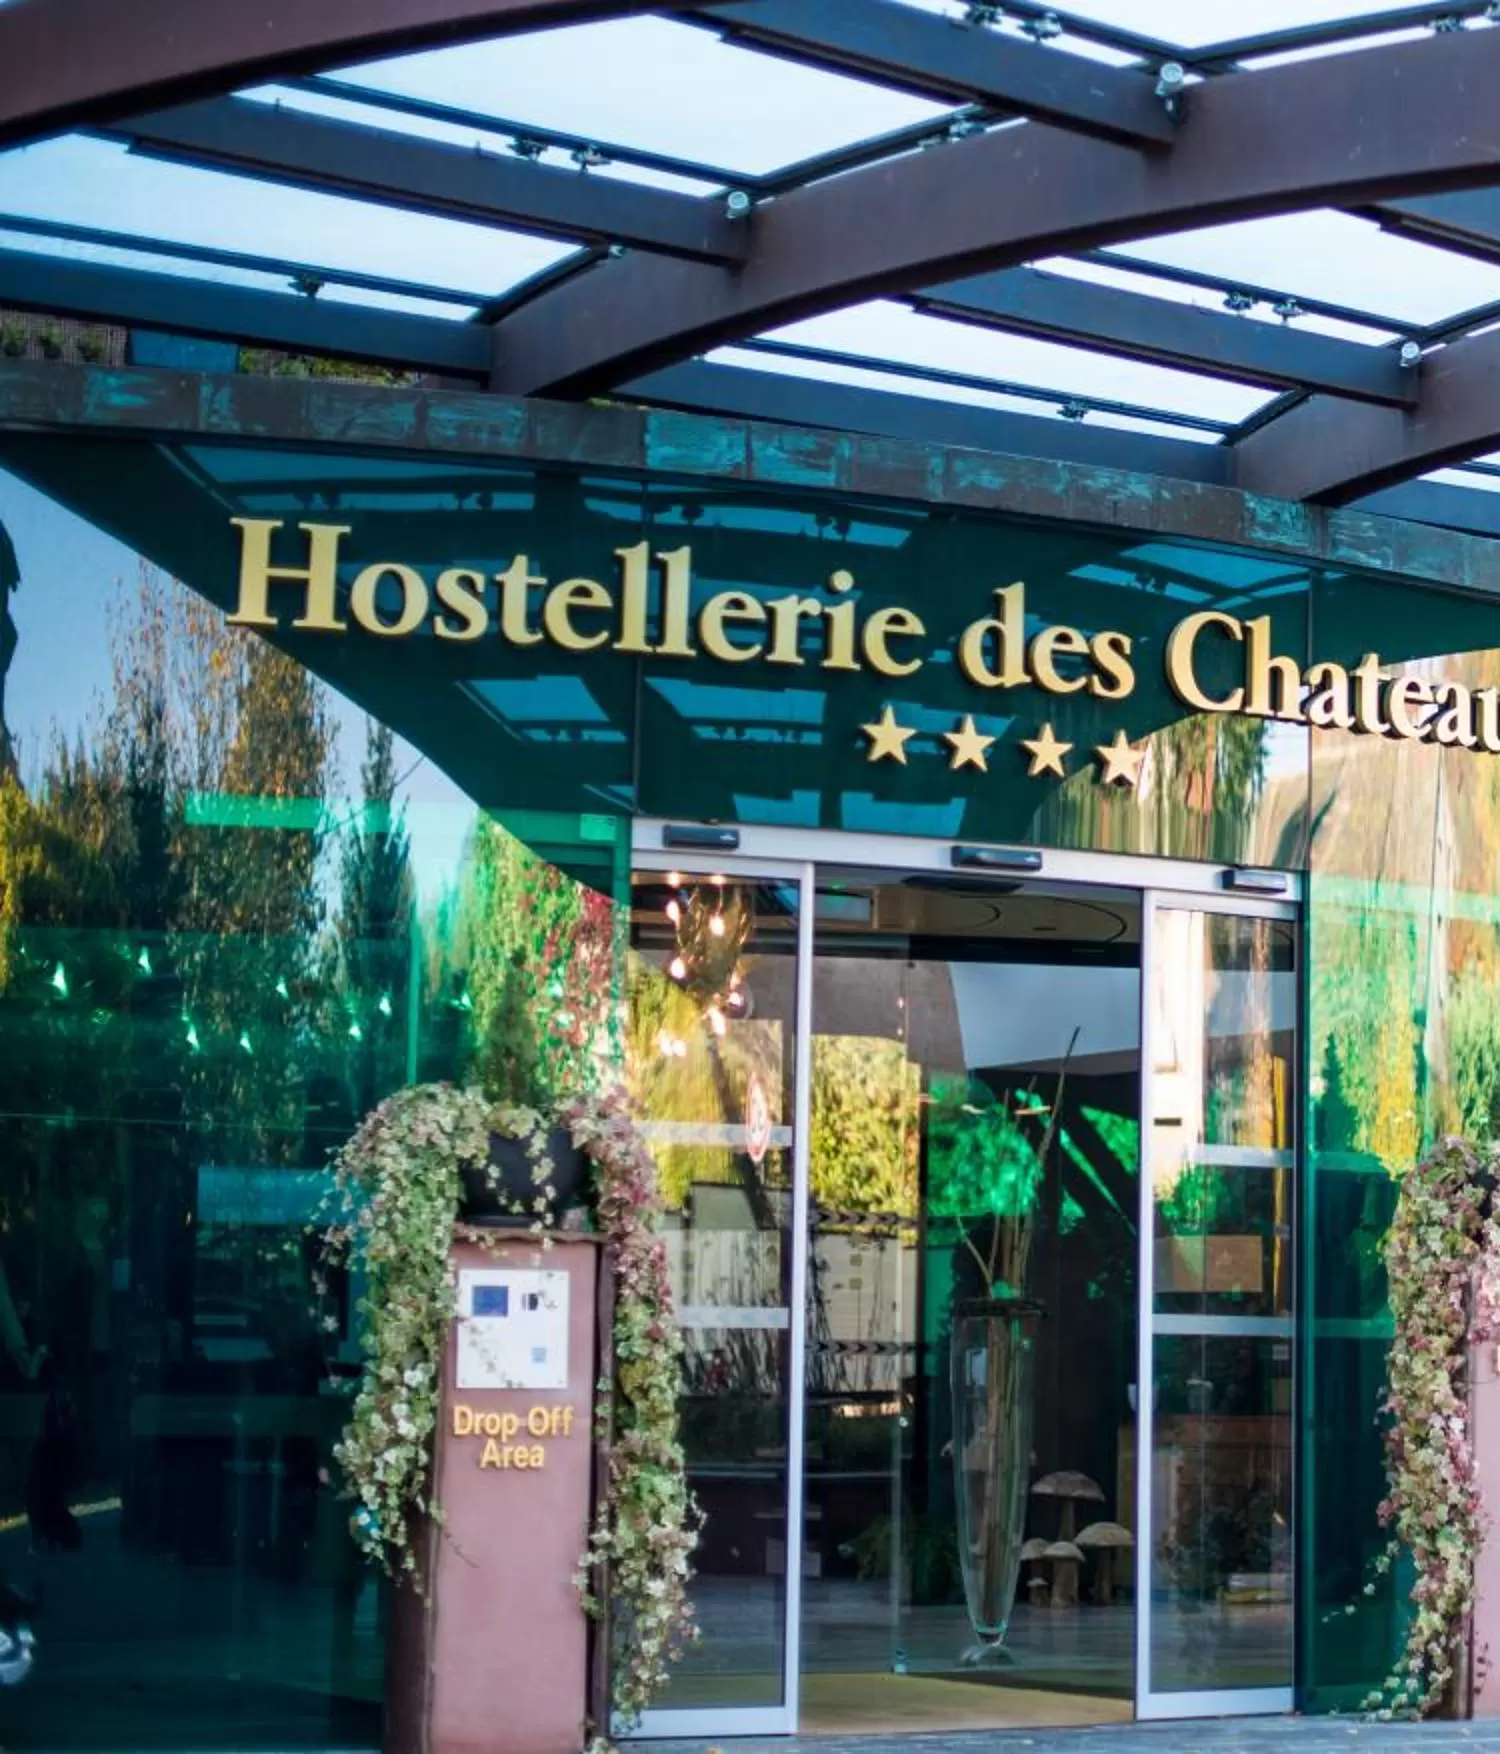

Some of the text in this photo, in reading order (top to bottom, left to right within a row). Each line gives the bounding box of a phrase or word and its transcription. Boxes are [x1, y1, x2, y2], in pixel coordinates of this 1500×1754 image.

[225, 516, 926, 676] Hostellerie
[958, 581, 1135, 699] des
[452, 1405, 574, 1441] Drop Off
[479, 1438, 545, 1469] Area
